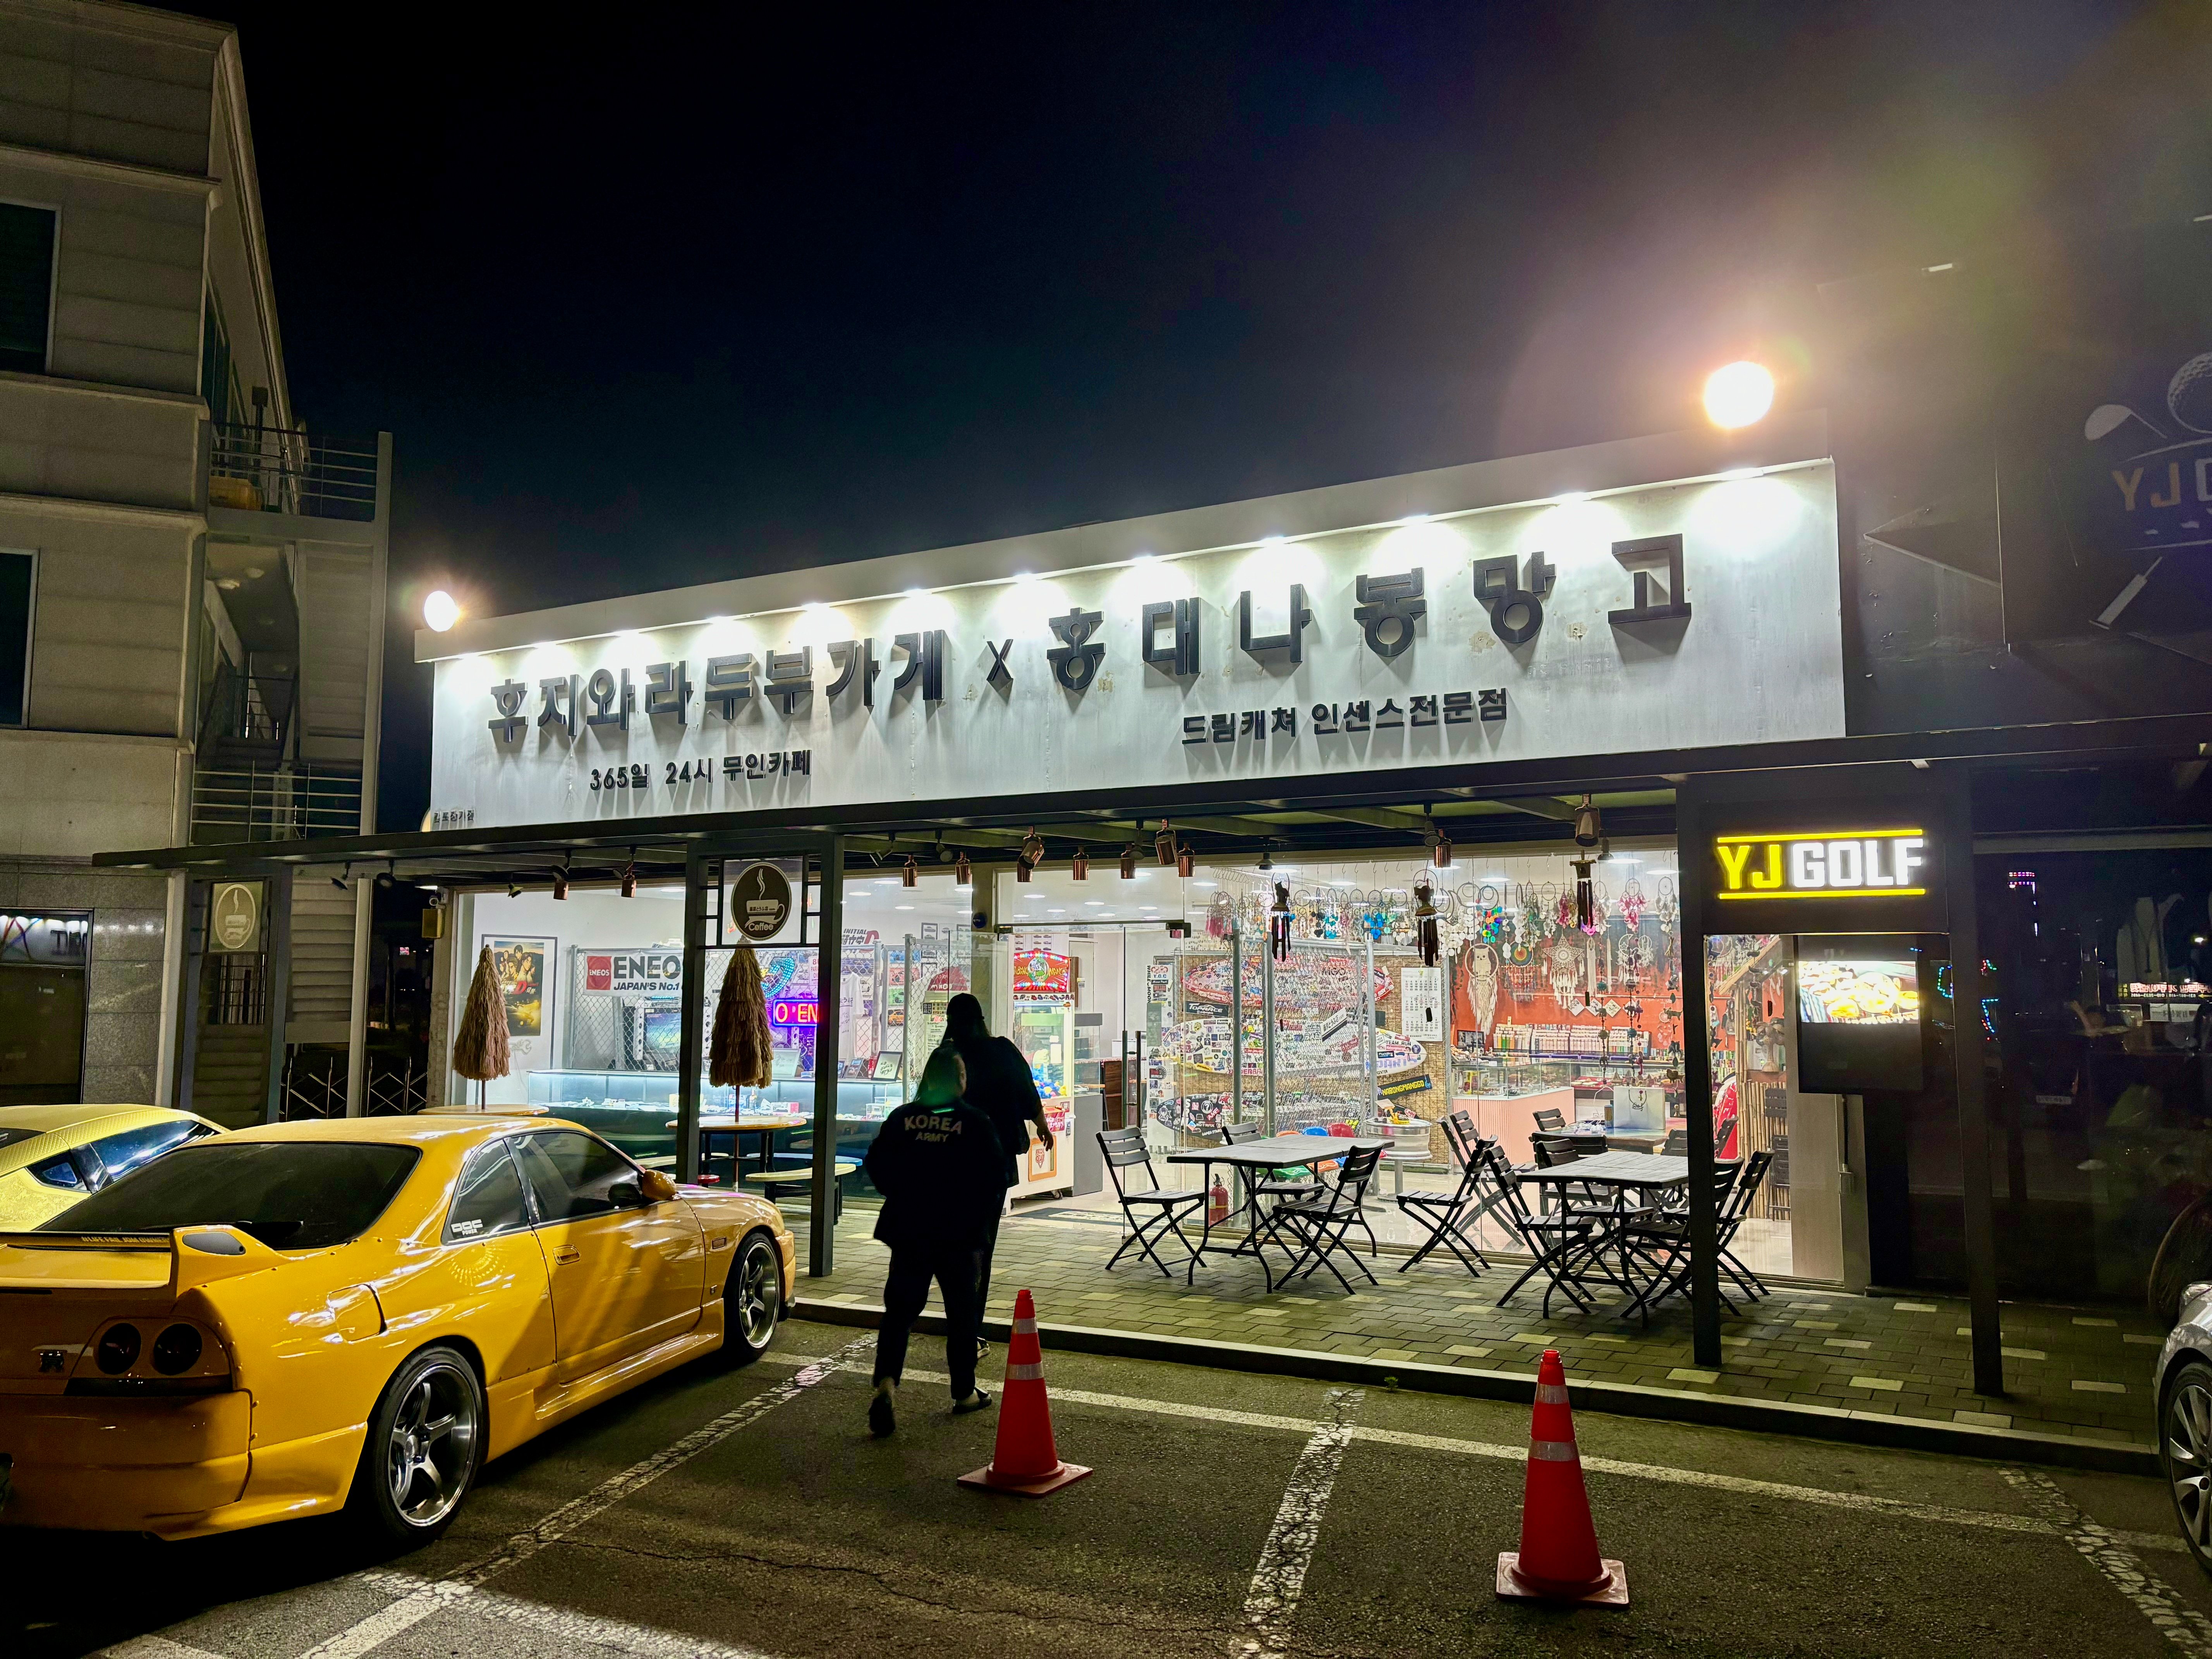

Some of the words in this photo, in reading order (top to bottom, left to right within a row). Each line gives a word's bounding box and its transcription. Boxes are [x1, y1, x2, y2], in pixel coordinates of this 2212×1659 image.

[1182, 707, 1297, 744] 드림캐쳐
[1312, 688, 1507, 735] 인센스전문점
[590, 763, 650, 791] 365일
[665, 757, 713, 785] 24시
[723, 749, 812, 781] 무인카페
[1717, 844, 1782, 890] YJ
[1791, 838, 1924, 888] GOLF
[748, 922, 774, 931] Coffee
[613, 955, 681, 980] ENEO
[613, 982, 657, 991] JAPAN'S
[658, 982, 680, 991] No.1
[775, 1003, 818, 1023] OEN
[904, 1114, 963, 1135] KOREA
[915, 1132, 949, 1142] ARMY
